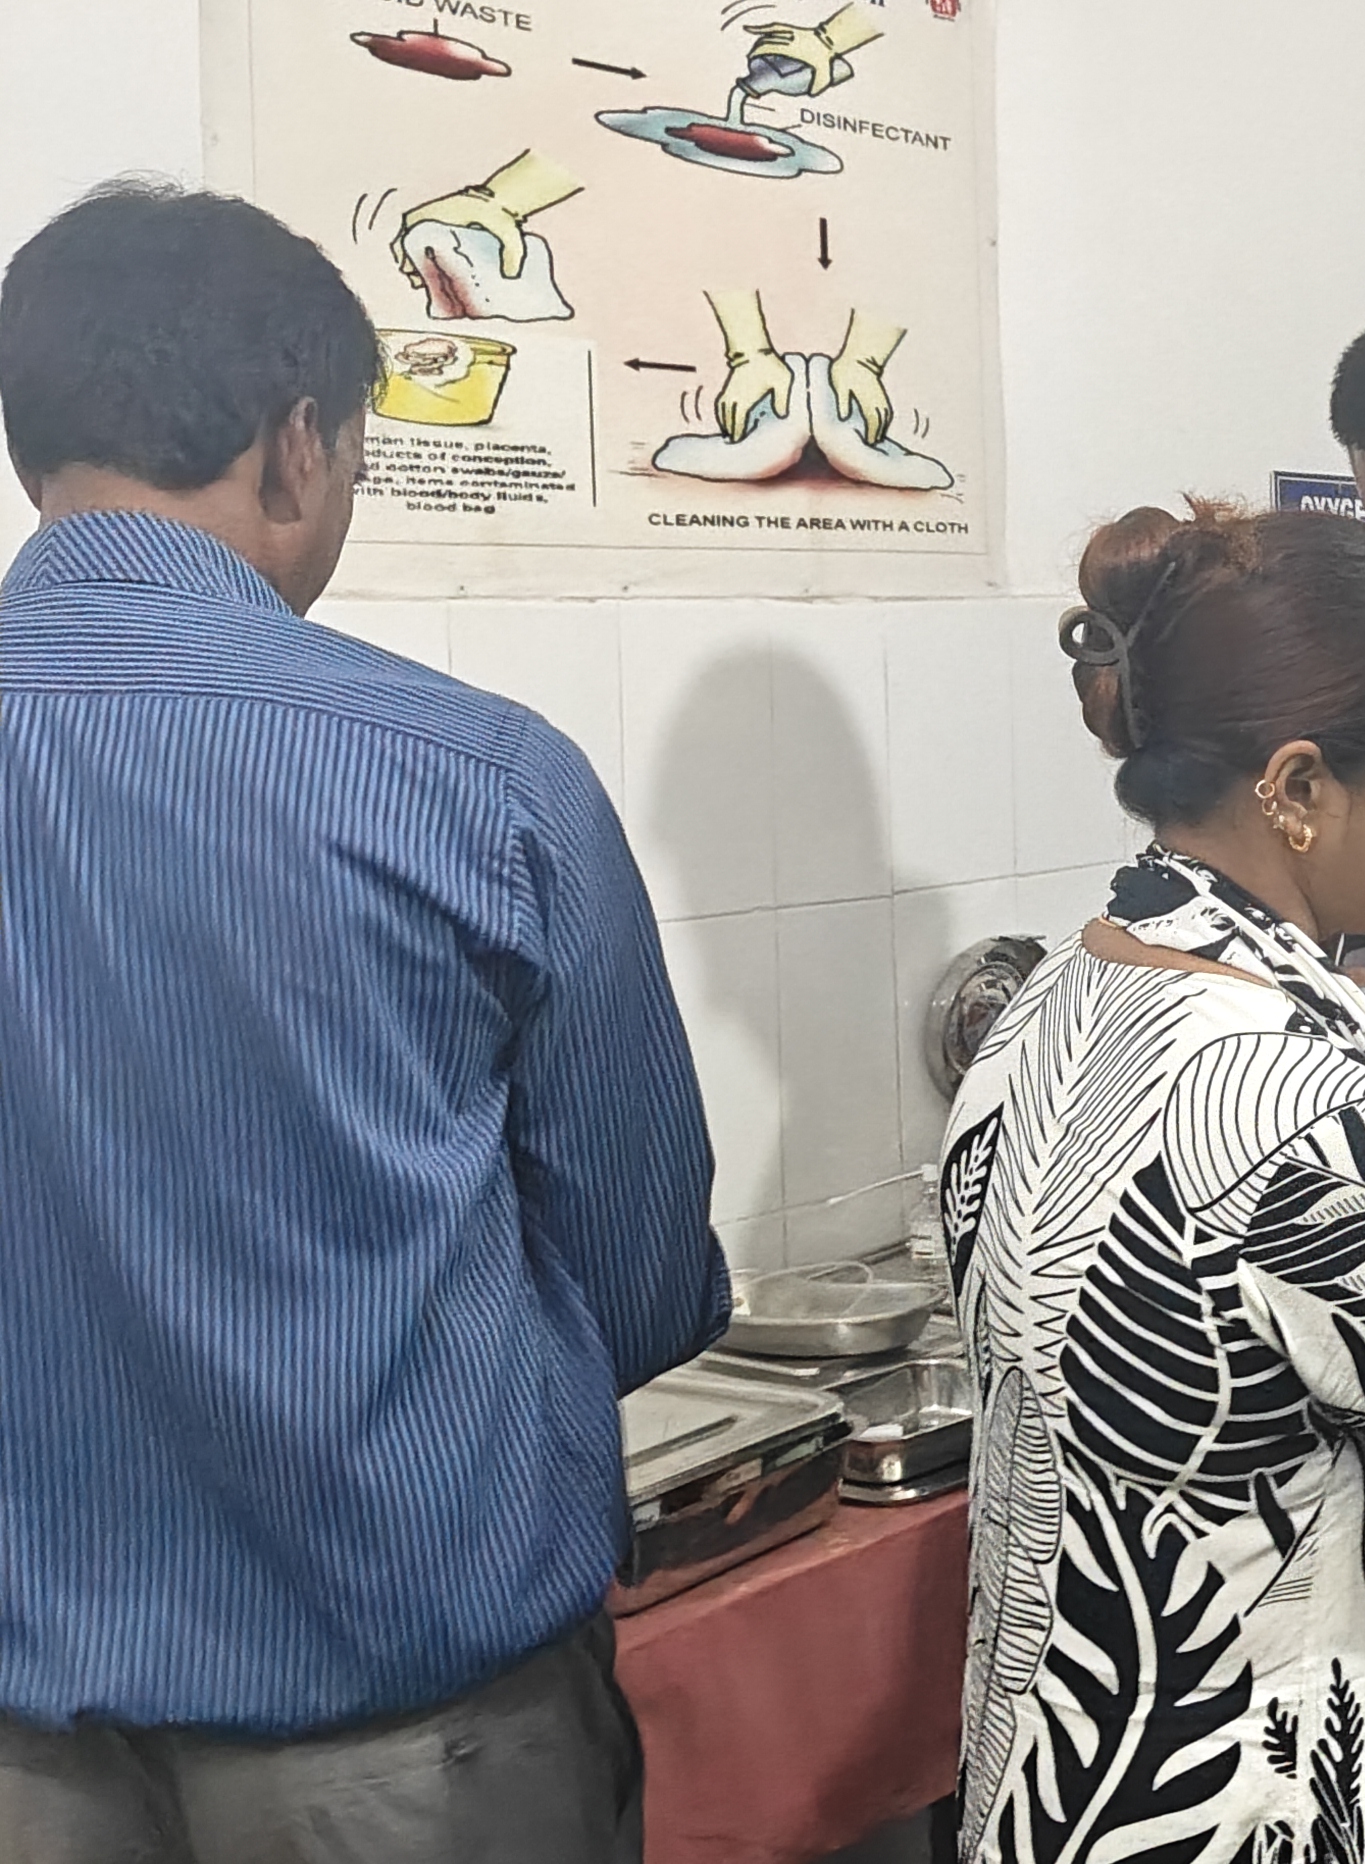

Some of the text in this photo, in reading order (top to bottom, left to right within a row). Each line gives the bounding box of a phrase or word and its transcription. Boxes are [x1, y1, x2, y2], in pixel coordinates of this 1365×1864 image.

[433, 0, 532, 31] WASTE
[800, 108, 952, 151] DISINFECTANT
[364, 436, 404, 446] man
[427, 451, 447, 461] of
[406, 501, 496, 515] blood bag
[647, 512, 970, 534] CLEANING THE AREA WITH A CLOTH
